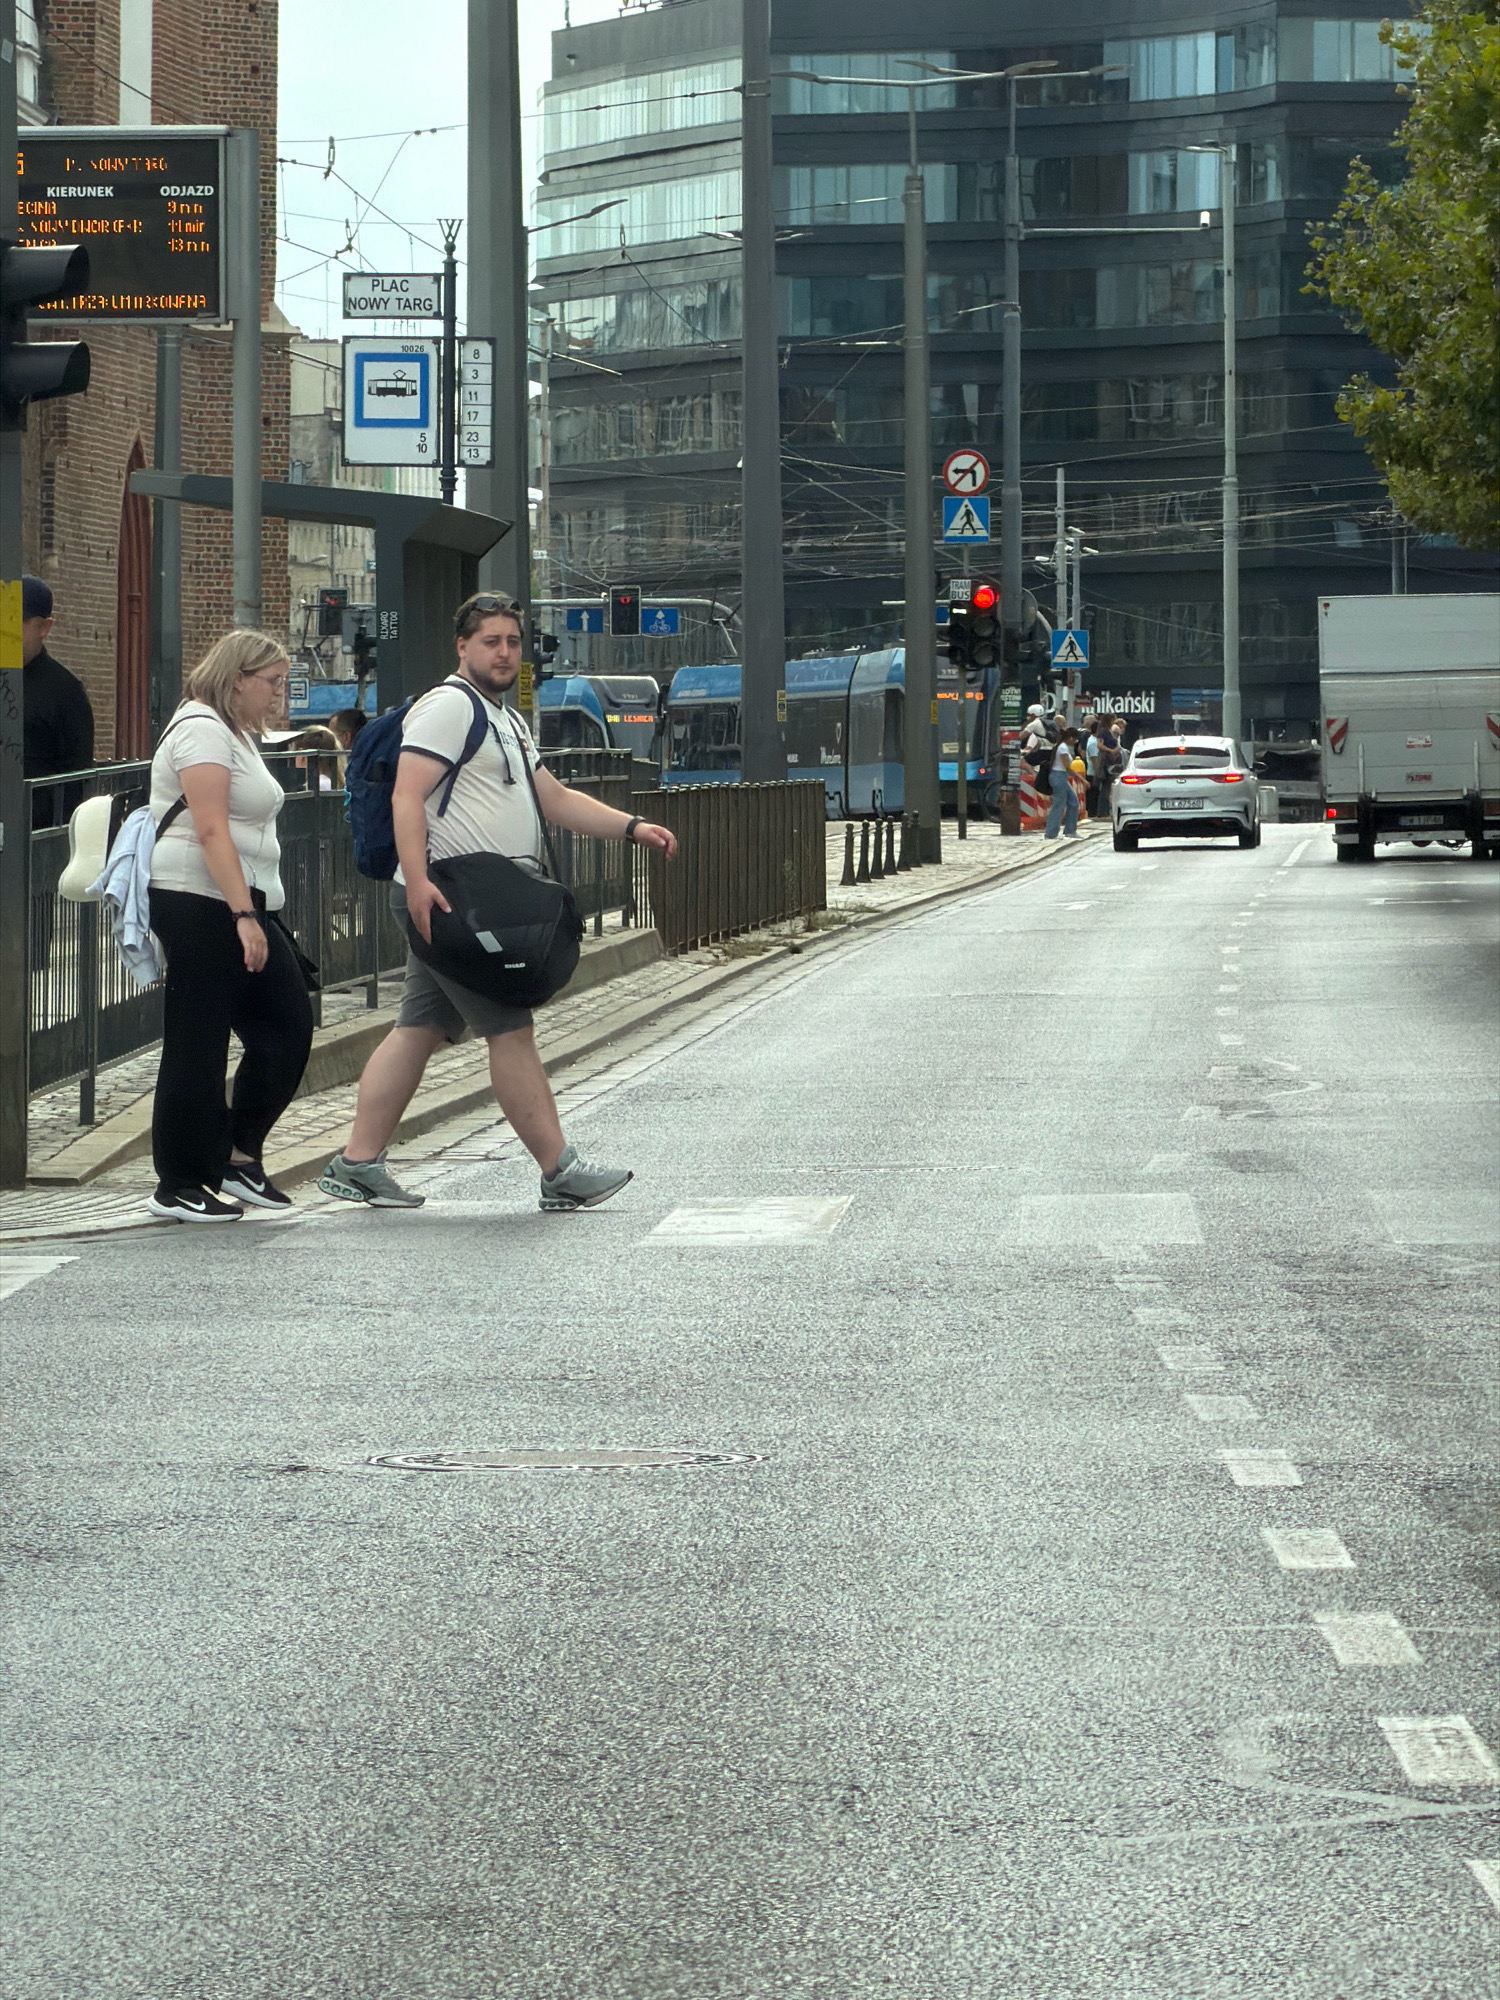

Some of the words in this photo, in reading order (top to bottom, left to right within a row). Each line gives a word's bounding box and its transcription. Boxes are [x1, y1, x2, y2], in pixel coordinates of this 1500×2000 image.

[46, 186, 114, 197] KIERUNEK
[160, 185, 214, 197] ODJAZD
[167, 200, 177, 214] 9
[179, 203, 203, 215] mn
[167, 238, 184, 252] 13
[186, 241, 210, 252] mn
[371, 279, 410, 293] PLAC
[348, 297, 391, 311] NOWY
[395, 297, 434, 312] TARG
[401, 345, 425, 353] 10026
[472, 349, 480, 360] 8
[471, 369, 479, 380] 3
[468, 391, 479, 402] 11
[467, 411, 479, 422] 17
[419, 432, 427, 443] 5
[466, 432, 479, 442] 23
[416, 443, 428, 454] 10
[467, 448, 480, 459] 13
[951, 580, 971, 590] TRAM
[951, 590, 970, 600] BUS
[380, 611, 389, 640] RIXARD
[390, 611, 398, 640] TATTOO
